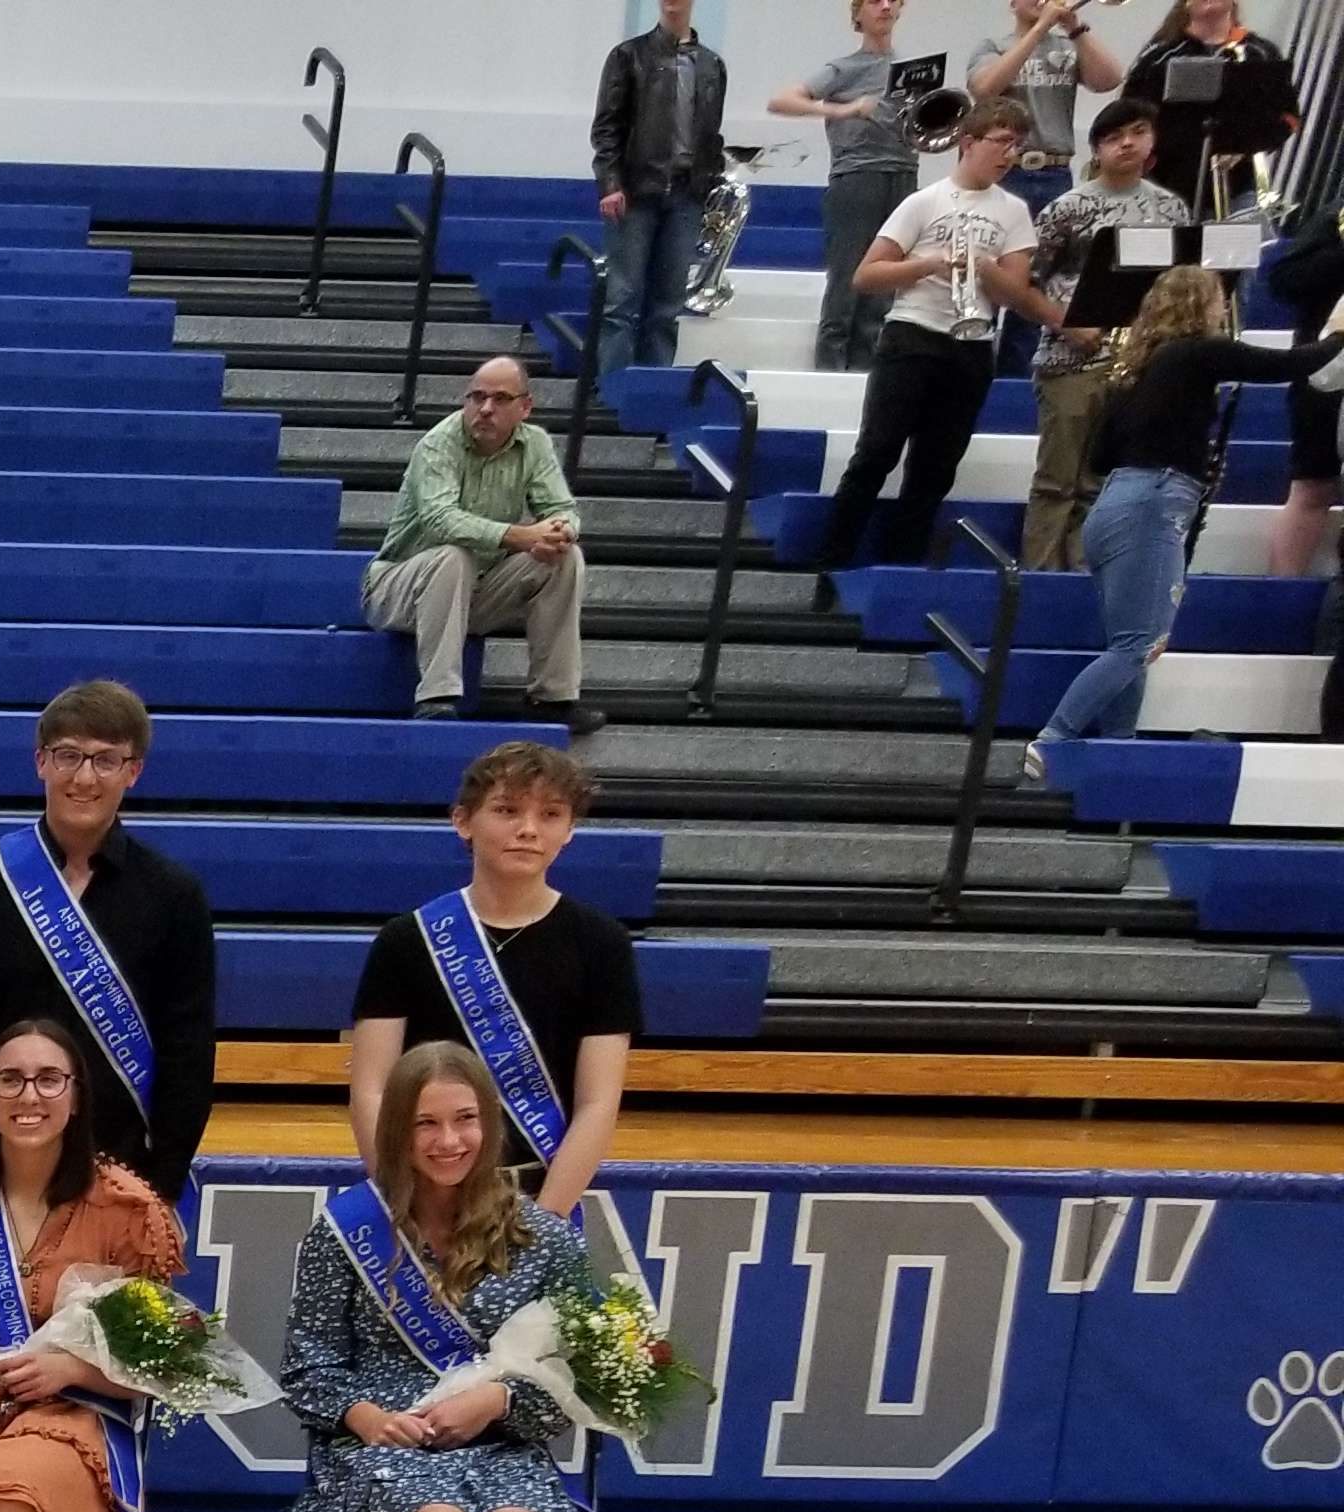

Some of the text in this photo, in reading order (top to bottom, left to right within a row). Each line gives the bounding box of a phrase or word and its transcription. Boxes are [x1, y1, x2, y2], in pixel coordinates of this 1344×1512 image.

[22, 885, 149, 1086] Junior Attendant
[57, 905, 144, 1043] AHS HOMECOMING 2021
[431, 915, 497, 1045] Sophomore
[471, 957, 552, 1104] AHS HOMECOMING 2021
[348, 1225, 440, 1352] Sopmore
[399, 1264, 427, 1294] AHS
